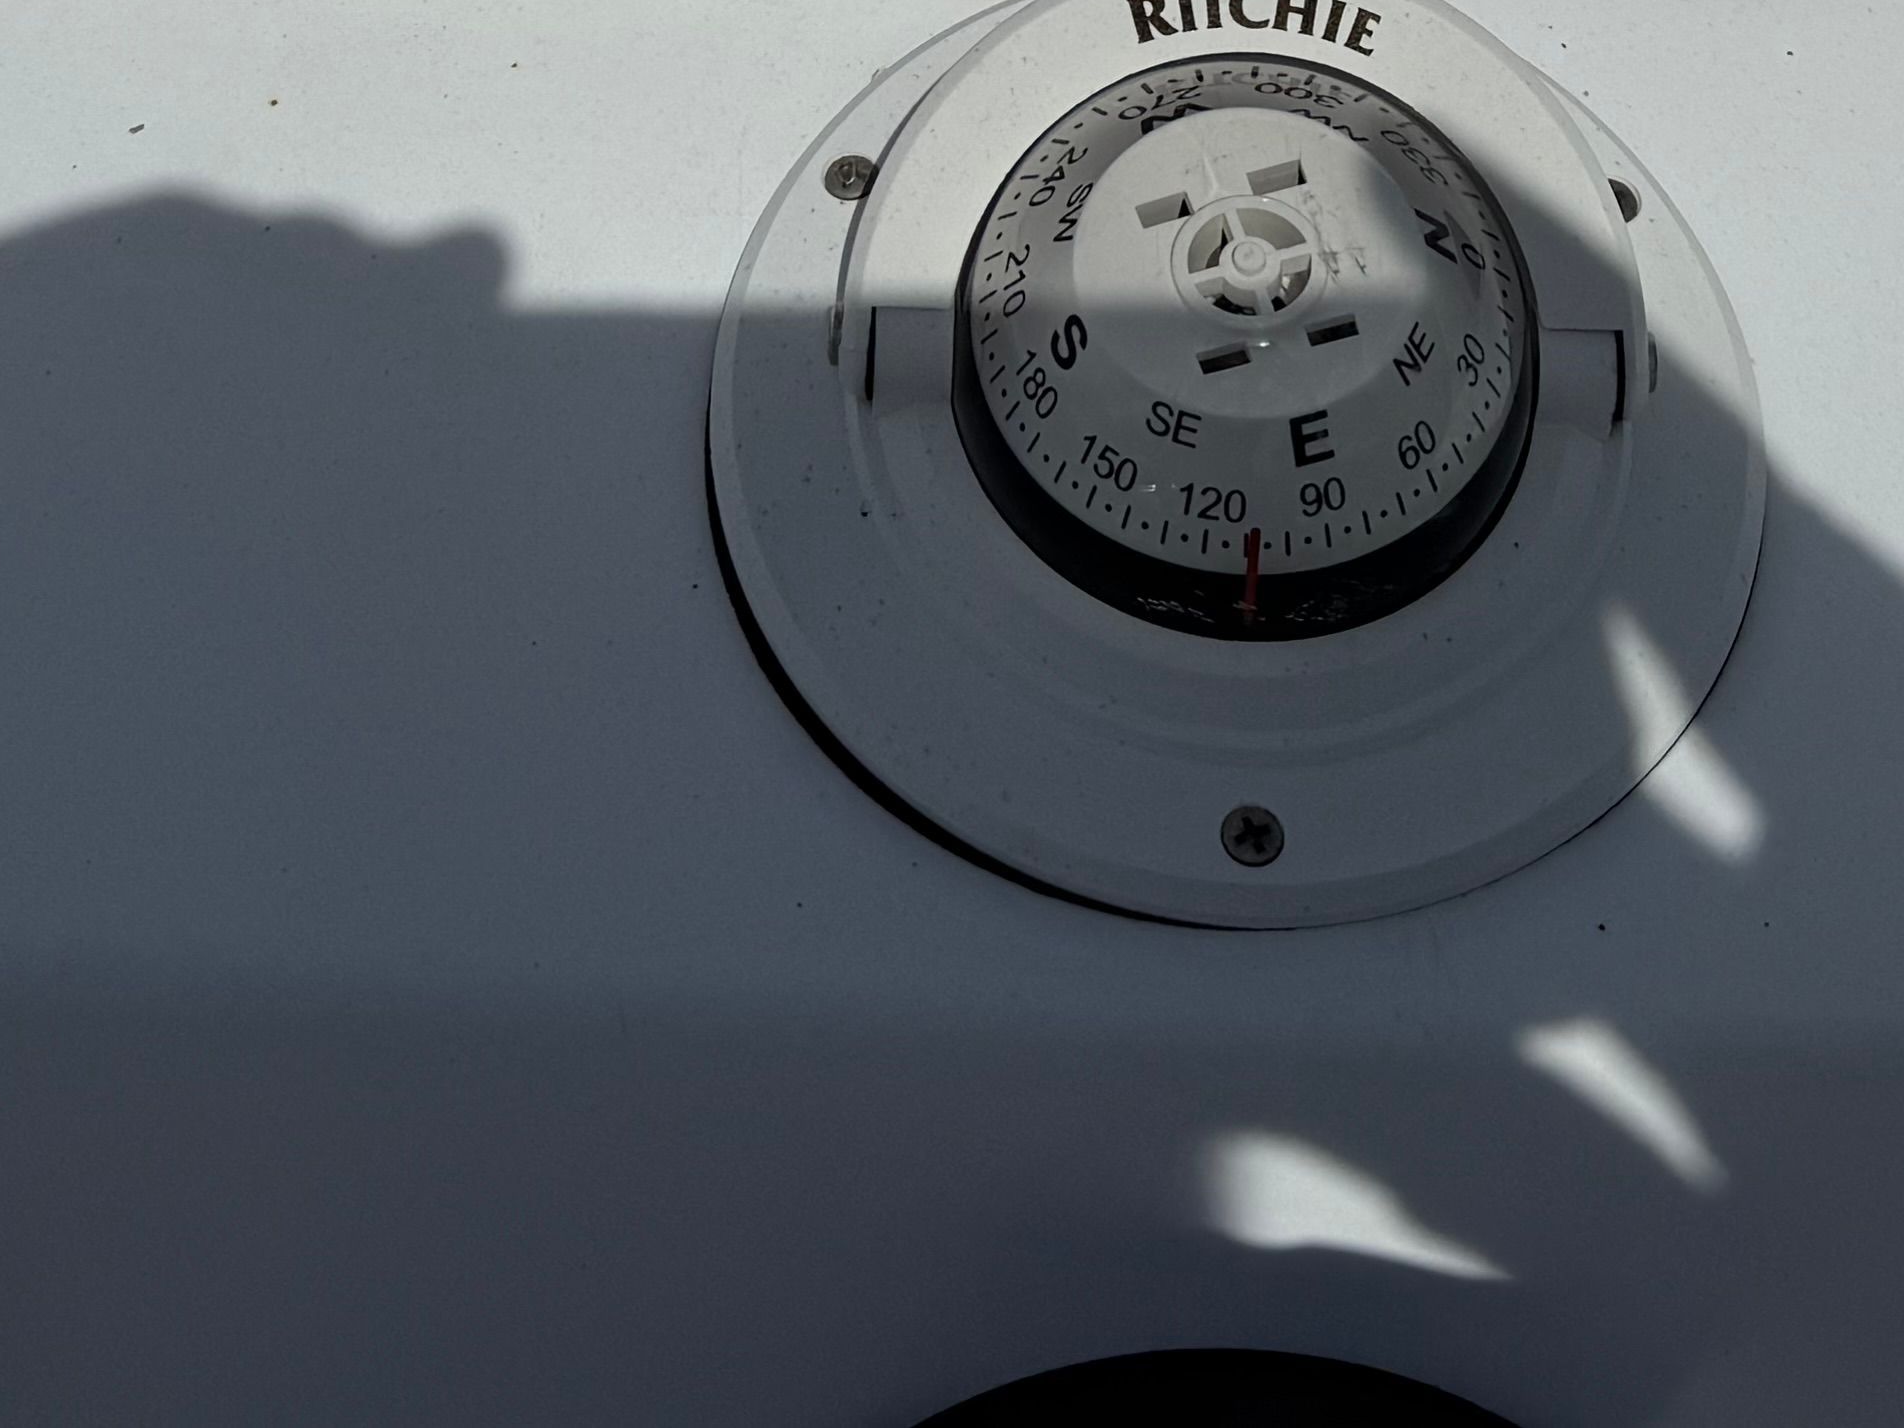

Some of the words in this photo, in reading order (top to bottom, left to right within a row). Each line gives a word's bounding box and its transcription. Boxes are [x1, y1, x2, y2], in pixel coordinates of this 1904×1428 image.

[1118, 85, 1201, 120] 270
[1254, 82, 1344, 109] 300
[1029, 146, 1088, 206] 240
[1380, 130, 1448, 185] 330
[1053, 182, 1094, 242] SW
[1413, 208, 1458, 264] N
[1003, 244, 1030, 318] 210
[1461, 242, 1485, 270] 0
[1051, 314, 1088, 370] S
[1392, 321, 1435, 386] NE
[1457, 333, 1485, 387] 30
[1016, 349, 1058, 419] 180
[1146, 401, 1202, 449] SE
[1289, 409, 1335, 467] E
[1398, 420, 1436, 470] 60
[1083, 435, 1138, 491] 150
[1180, 482, 1247, 523] 120
[1300, 477, 1346, 517] 90
